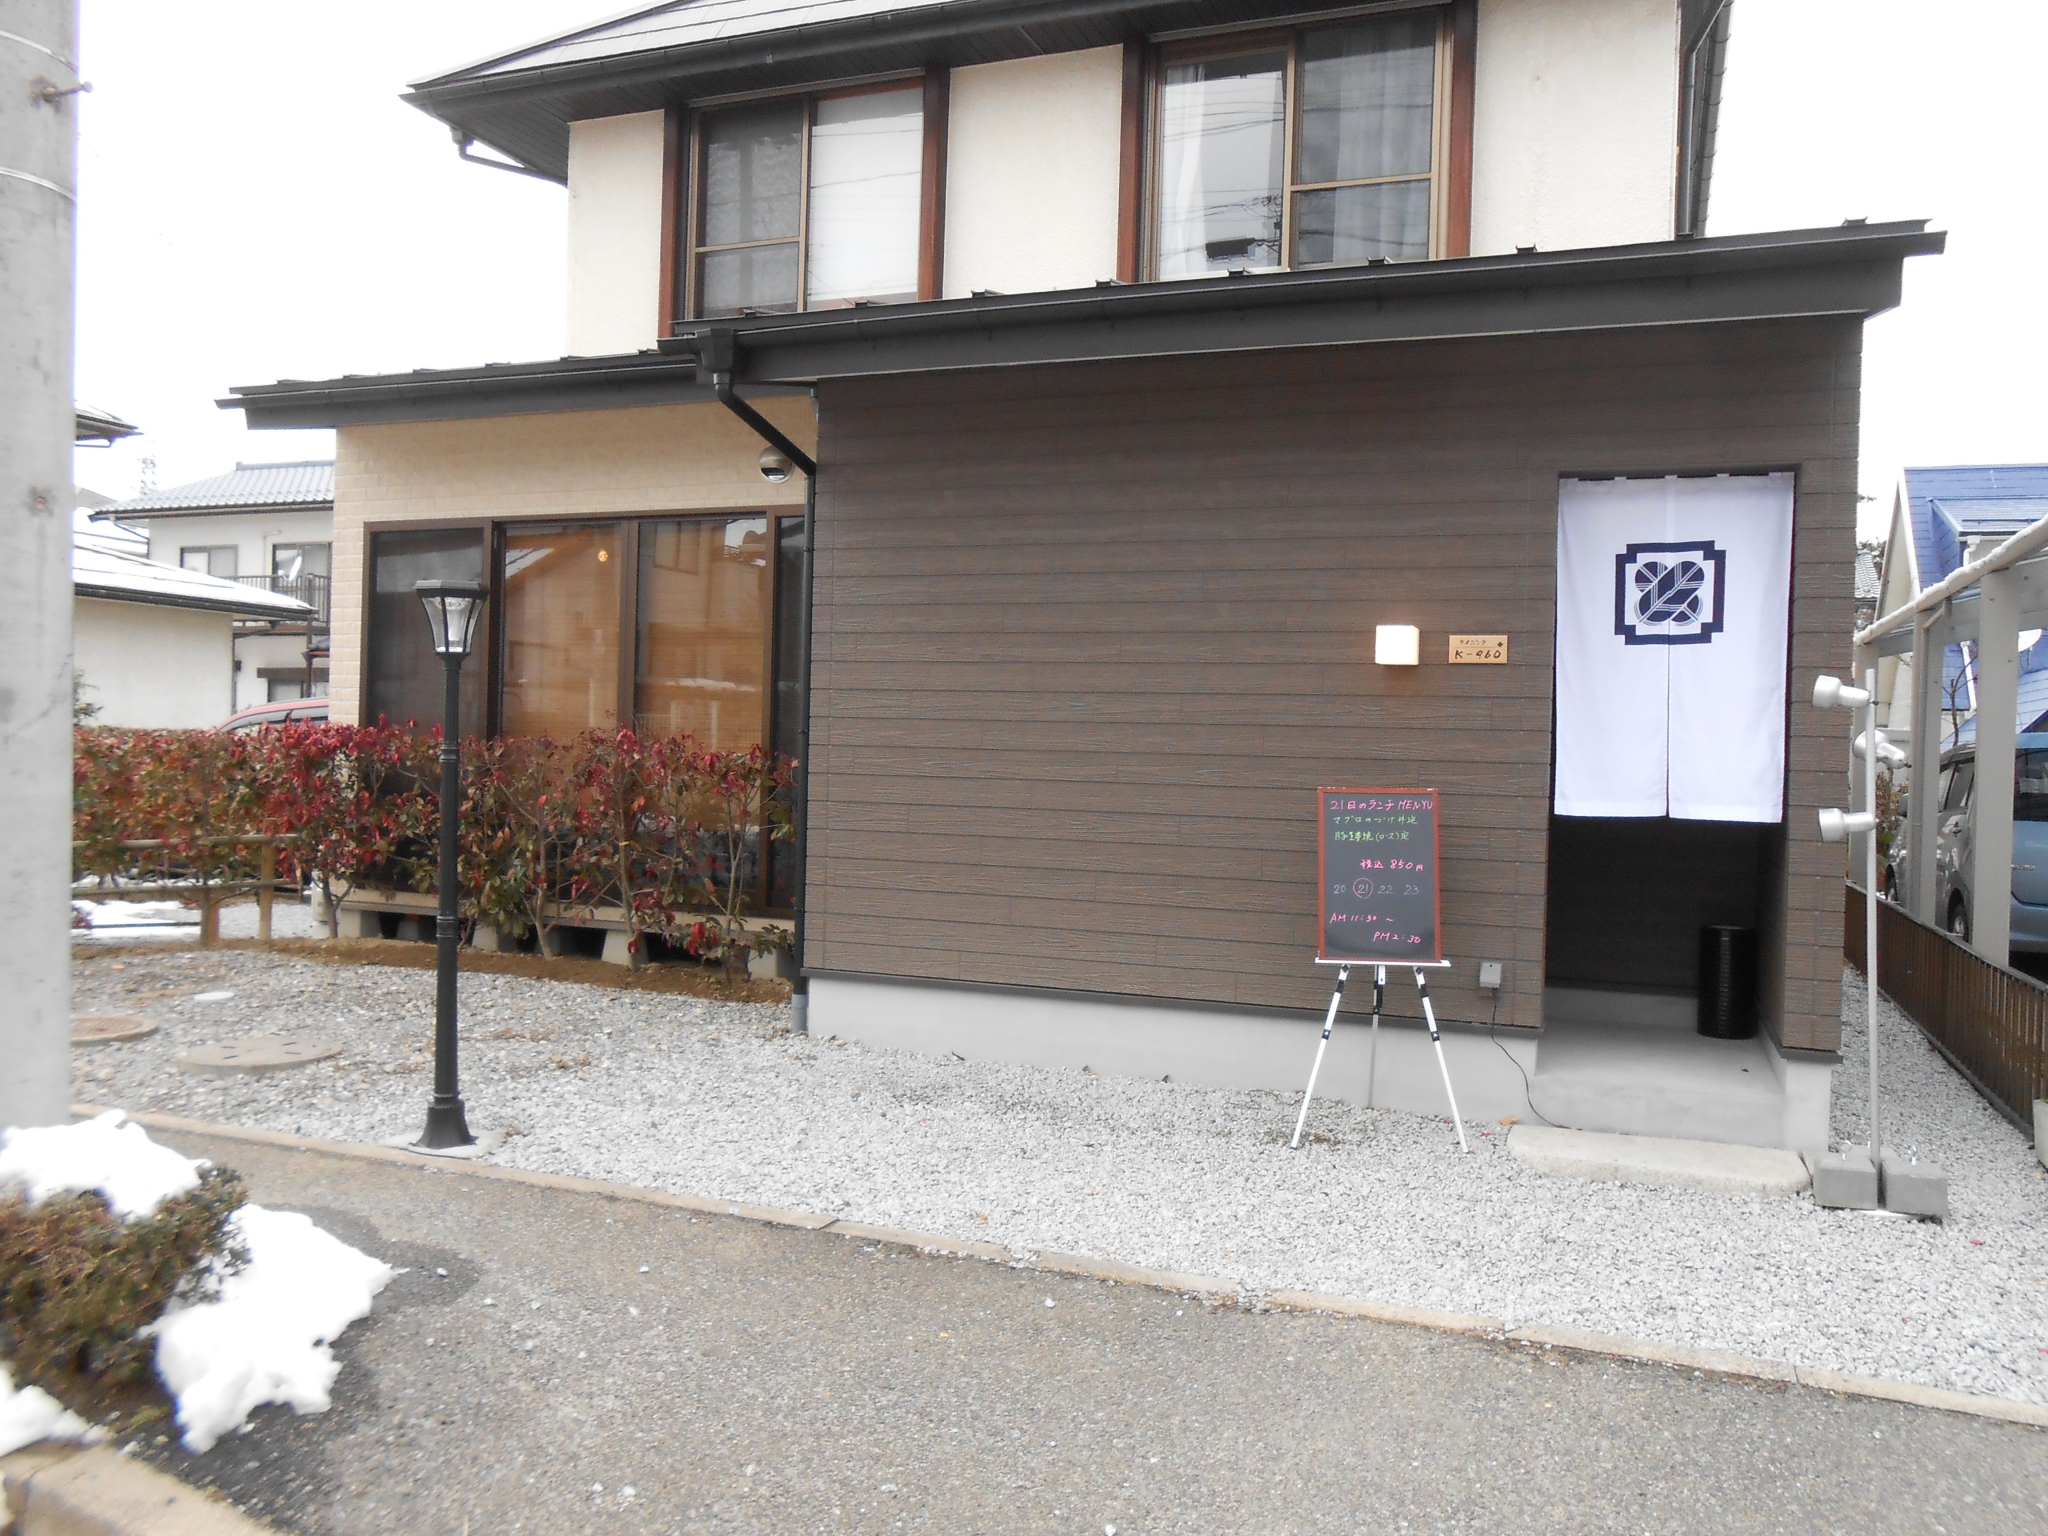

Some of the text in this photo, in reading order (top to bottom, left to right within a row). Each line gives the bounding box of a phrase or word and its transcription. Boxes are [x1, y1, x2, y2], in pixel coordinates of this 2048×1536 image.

[1334, 884, 1419, 895] 20 21 22 23
[1330, 914, 1346, 923] AM
[1350, 914, 1377, 922] 11:30
[1373, 932, 1390, 941] PM
